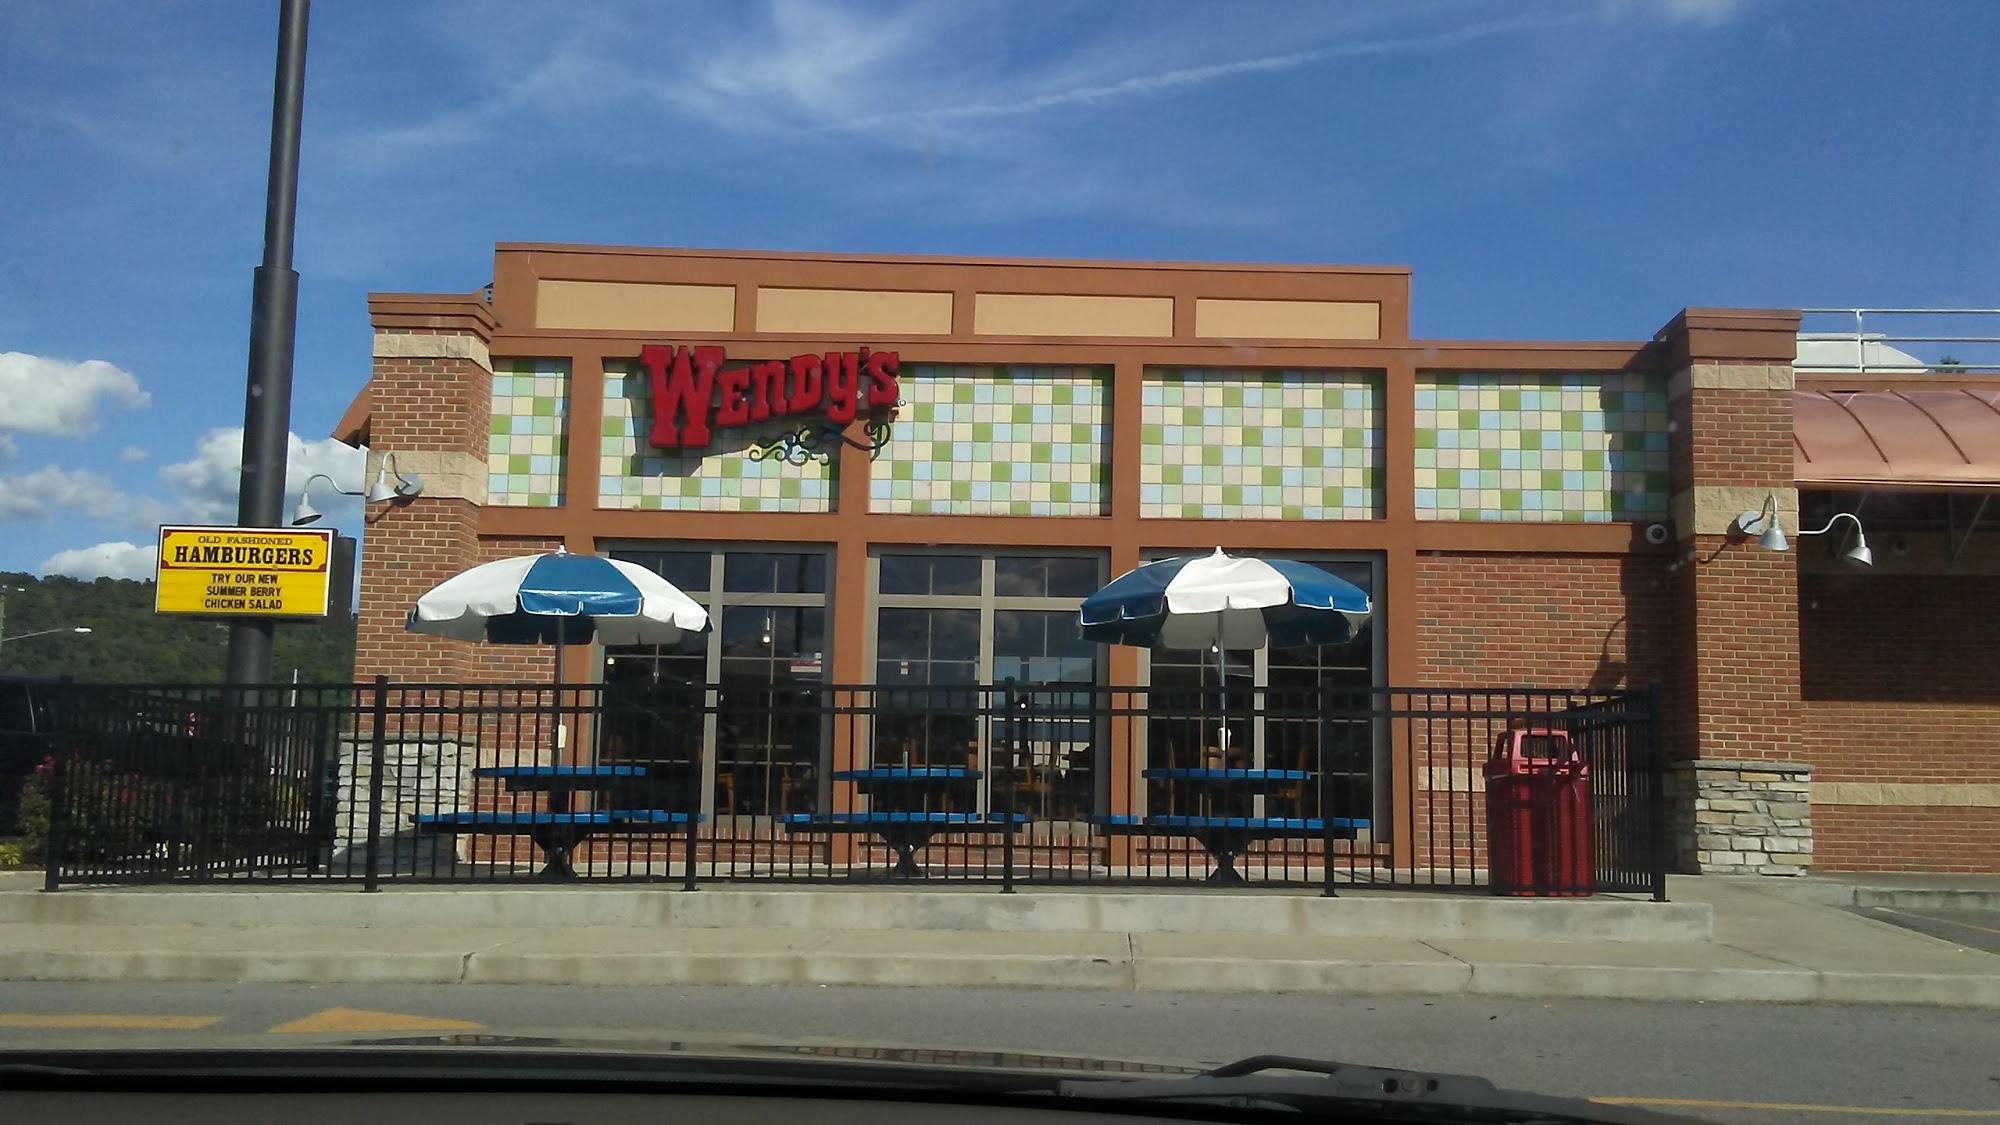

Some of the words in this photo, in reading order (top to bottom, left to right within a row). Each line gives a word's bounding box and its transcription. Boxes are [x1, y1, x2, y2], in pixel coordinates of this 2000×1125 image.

[641, 344, 899, 447] Wendy's
[198, 535, 221, 544] OLD
[226, 536, 293, 545] FASHIONED
[174, 546, 313, 565] HAMBURGERS
[211, 573, 231, 584] TRY
[235, 574, 255, 584] OUR
[258, 574, 279, 584] NEW
[206, 586, 247, 596] SUMMER
[250, 587, 282, 597] BERRY
[204, 599, 245, 609] CHICKEN
[249, 599, 282, 610] SALAD
